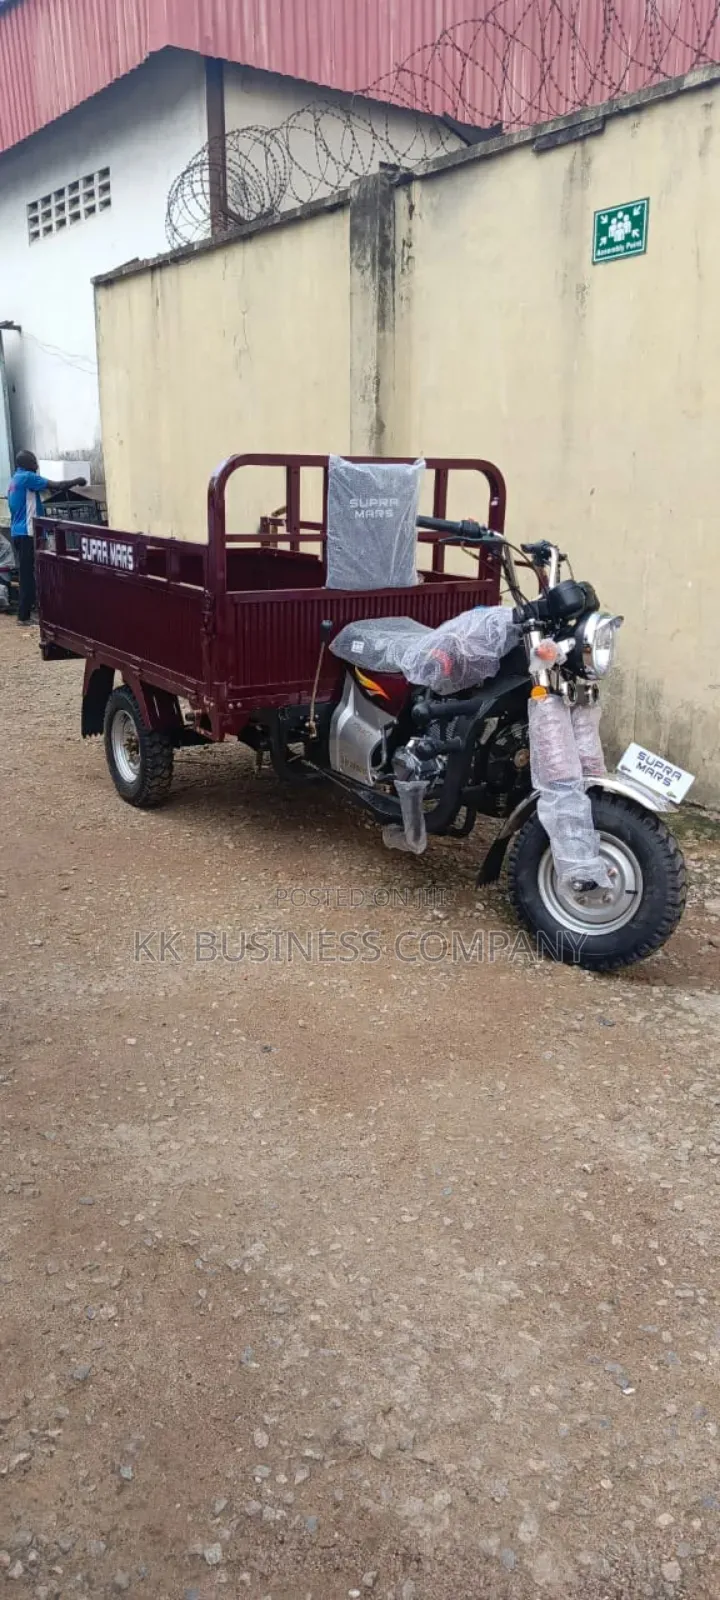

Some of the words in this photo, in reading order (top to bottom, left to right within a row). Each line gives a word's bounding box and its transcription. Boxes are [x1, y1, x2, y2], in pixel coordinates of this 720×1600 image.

[349, 498, 399, 508] SUPRA
[354, 509, 393, 519] MARS
[81, 537, 108, 565] SUPRA
[110, 542, 133, 571] MARS
[636, 761, 672, 786] MARS
[637, 751, 682, 780] SUPRA
